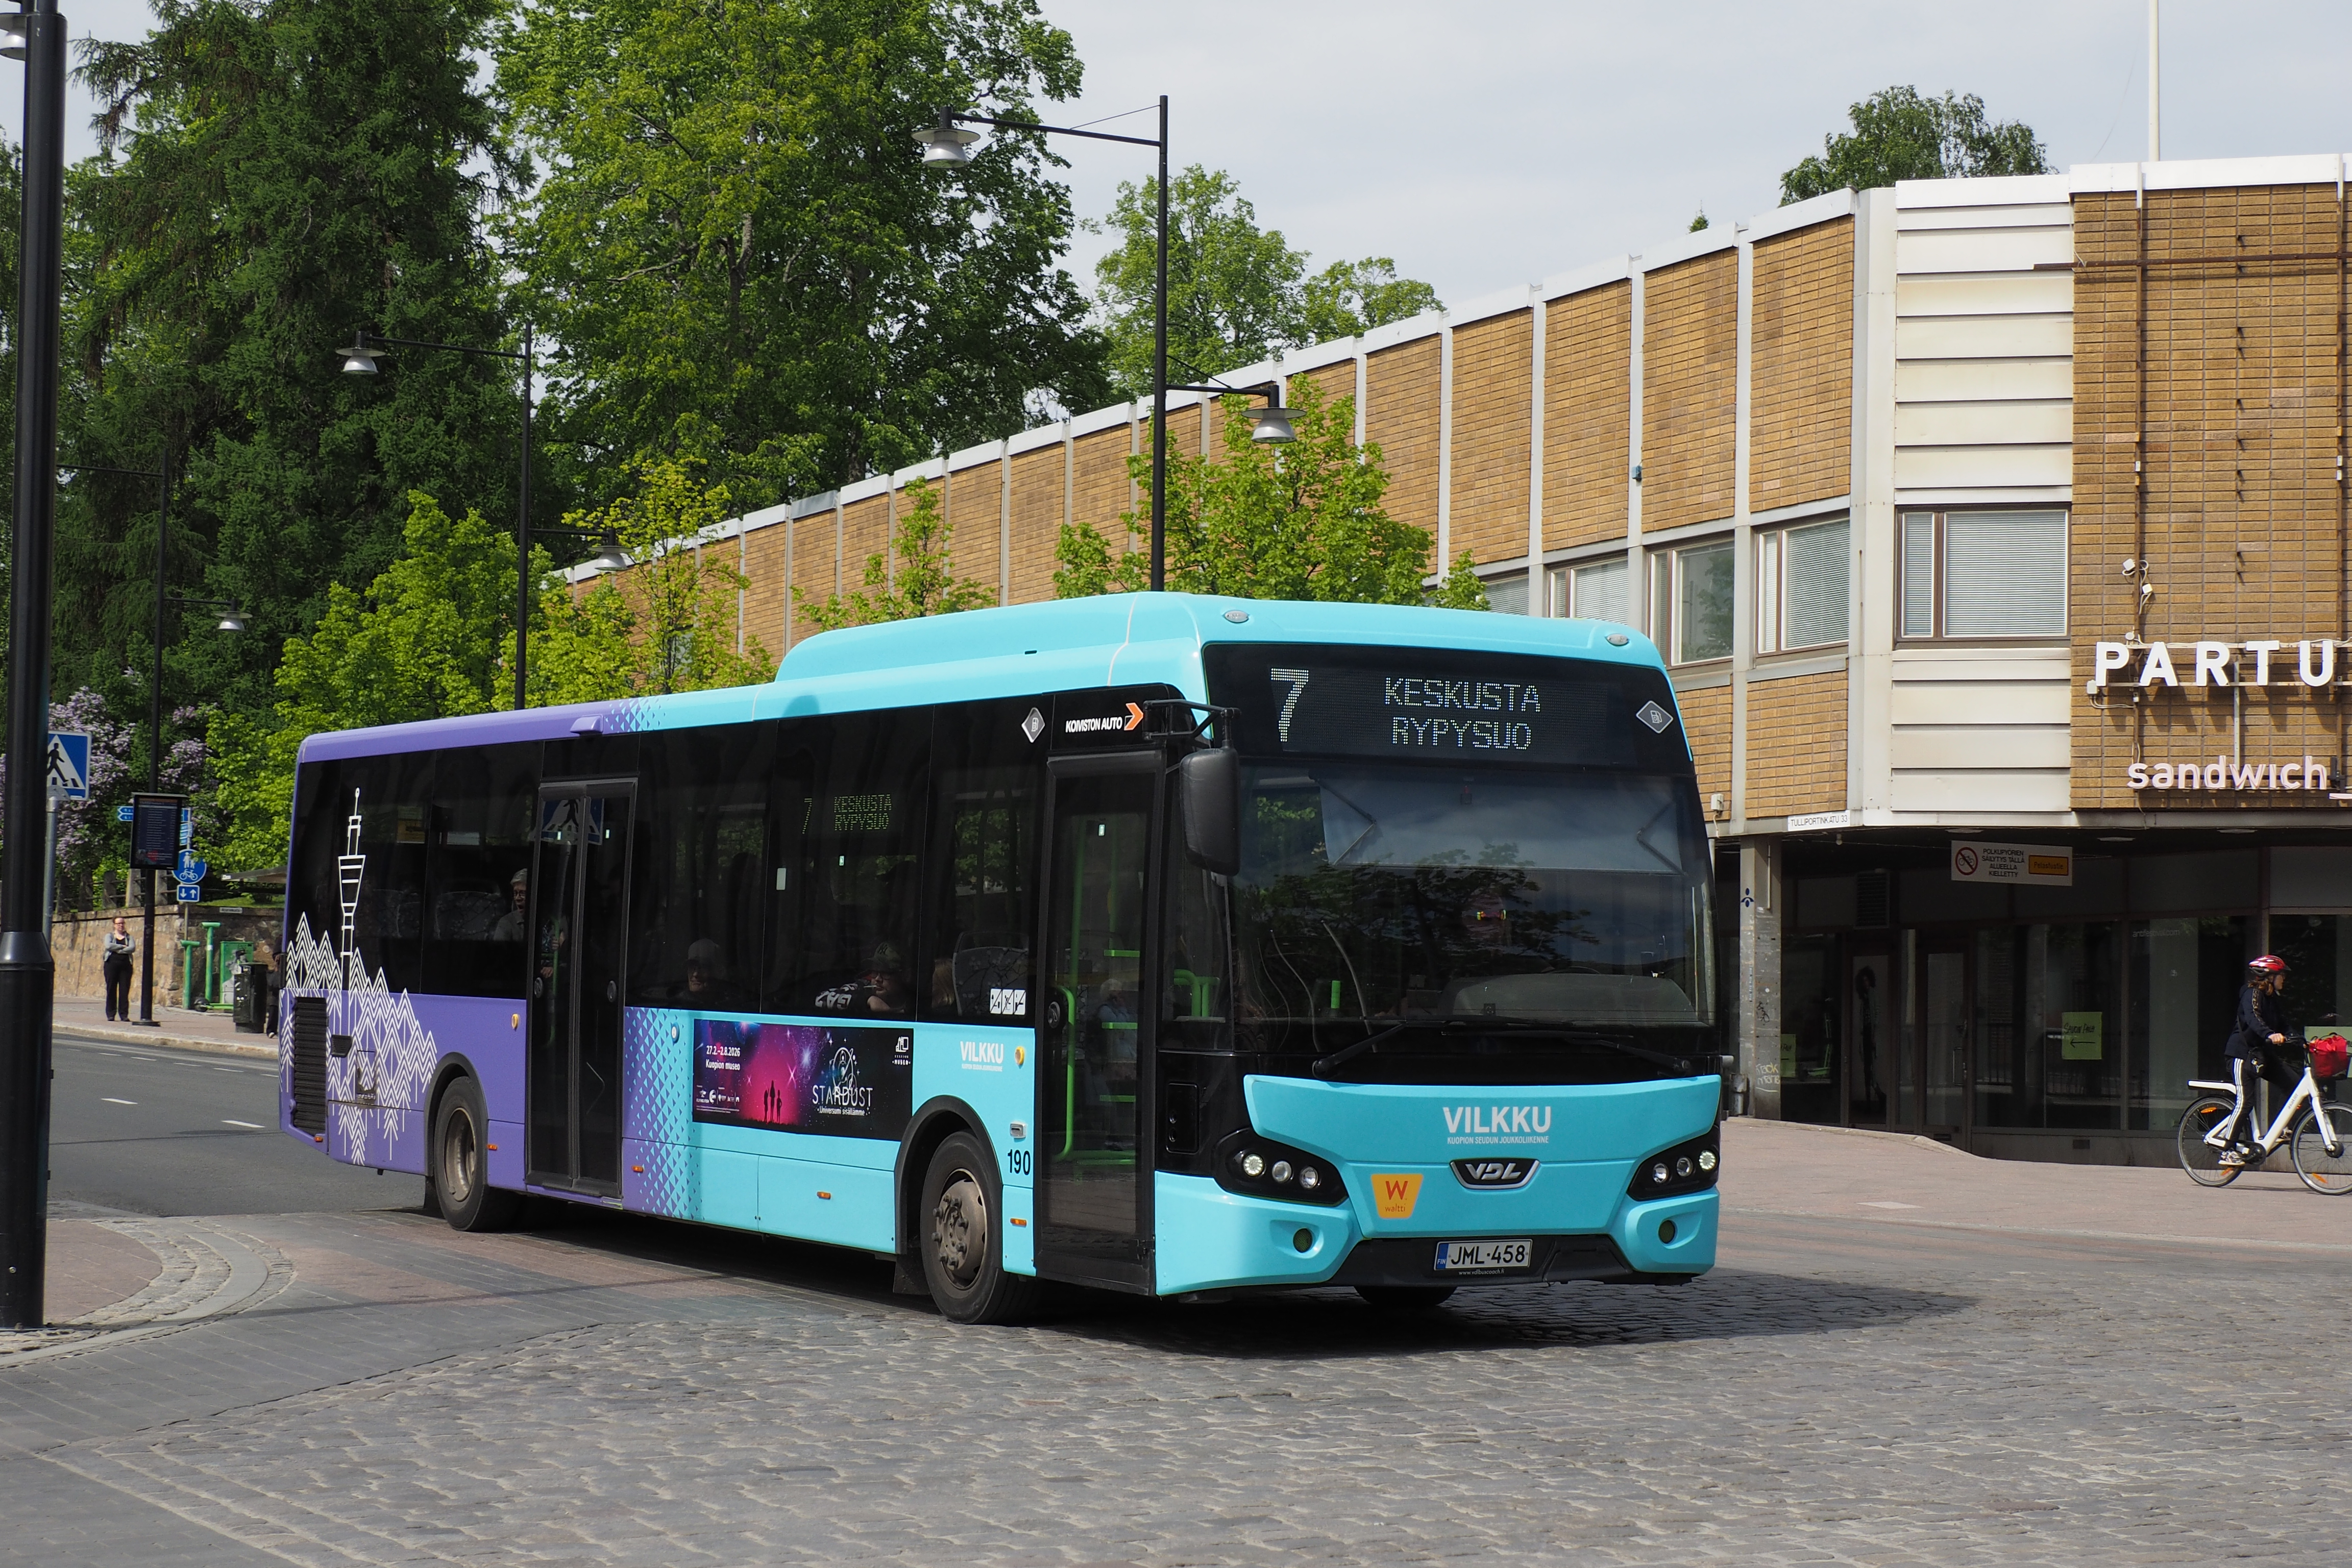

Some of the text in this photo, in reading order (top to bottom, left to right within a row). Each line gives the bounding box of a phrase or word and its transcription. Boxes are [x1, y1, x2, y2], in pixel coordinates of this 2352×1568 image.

[2095, 640, 2334, 687] PARTU
[1385, 676, 1541, 714] KESKUSTA
[1271, 668, 1309, 743] 7
[1065, 716, 1123, 733] KOIVISTON AUTO
[1391, 716, 1532, 750] RYPYSUO
[2127, 755, 2327, 790] sandwich
[834, 794, 892, 813] KESKUSTA
[802, 797, 813, 835] 7
[835, 813, 890, 831] RYPYSUO
[1791, 815, 1848, 827] TULLIPORTINKATU 33
[1983, 848, 2024, 856] POLKUPYÖRIEN
[2034, 861, 2064, 870] Pelastustie
[960, 1041, 1004, 1064] VILKKU
[705, 1059, 741, 1071] Kuopion museo
[812, 1084, 873, 1107] STARDUST
[819, 1105, 865, 1116] Universumi sisällämme
[1442, 1106, 1552, 1134] VILKKU
[1447, 1136, 1474, 1144] KUOPION
[1499, 1136, 1549, 1144] JOUKKOLIIKENNE
[1007, 1148, 1031, 1176] 190
[1465, 1163, 1522, 1180] VDL
[1385, 1180, 1408, 1200] W
[1385, 1203, 1406, 1212] waltti
[1451, 1244, 1525, 1265] JML-458
